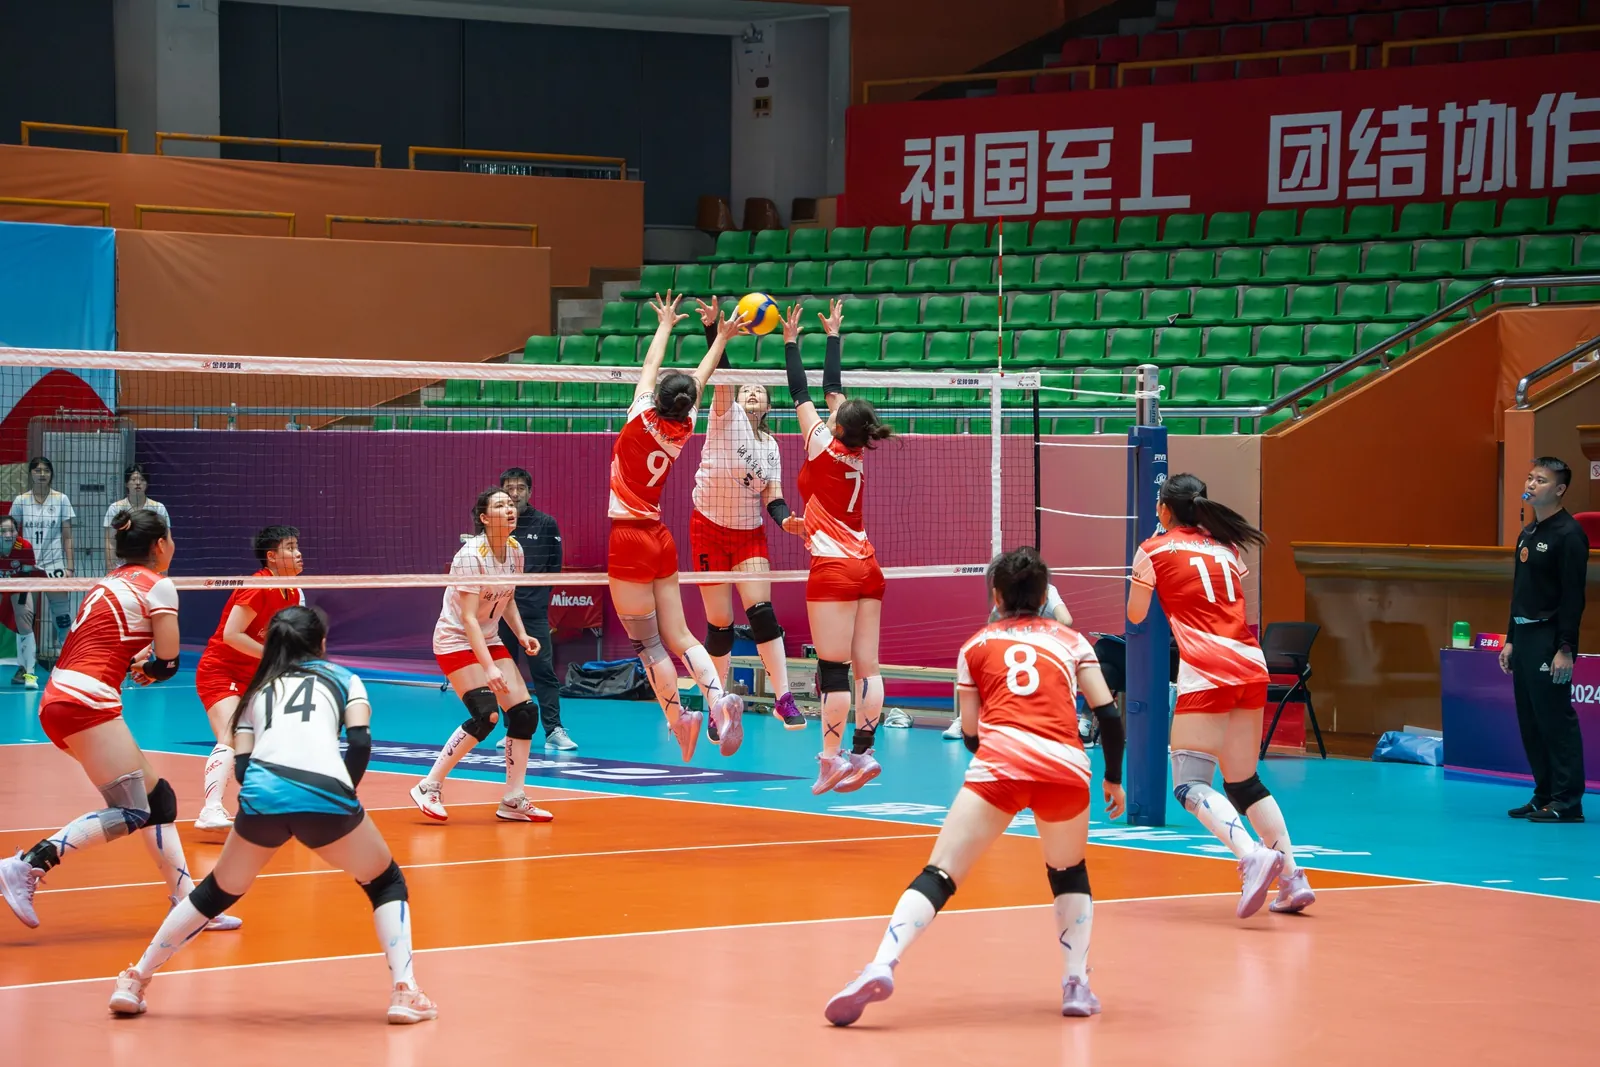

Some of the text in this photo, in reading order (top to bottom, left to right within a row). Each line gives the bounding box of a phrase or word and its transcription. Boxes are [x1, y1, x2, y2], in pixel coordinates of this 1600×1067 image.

[900, 92, 1600, 221] 祖国至上 团结协作
[646, 450, 671, 487] 9
[845, 469, 862, 513] 7
[35, 530, 43, 545] 11
[550, 593, 595, 607] MIKASA
[1189, 555, 1237, 603] 11
[489, 600, 499, 619] 1
[1003, 643, 1040, 696] 8
[261, 675, 318, 732] 14
